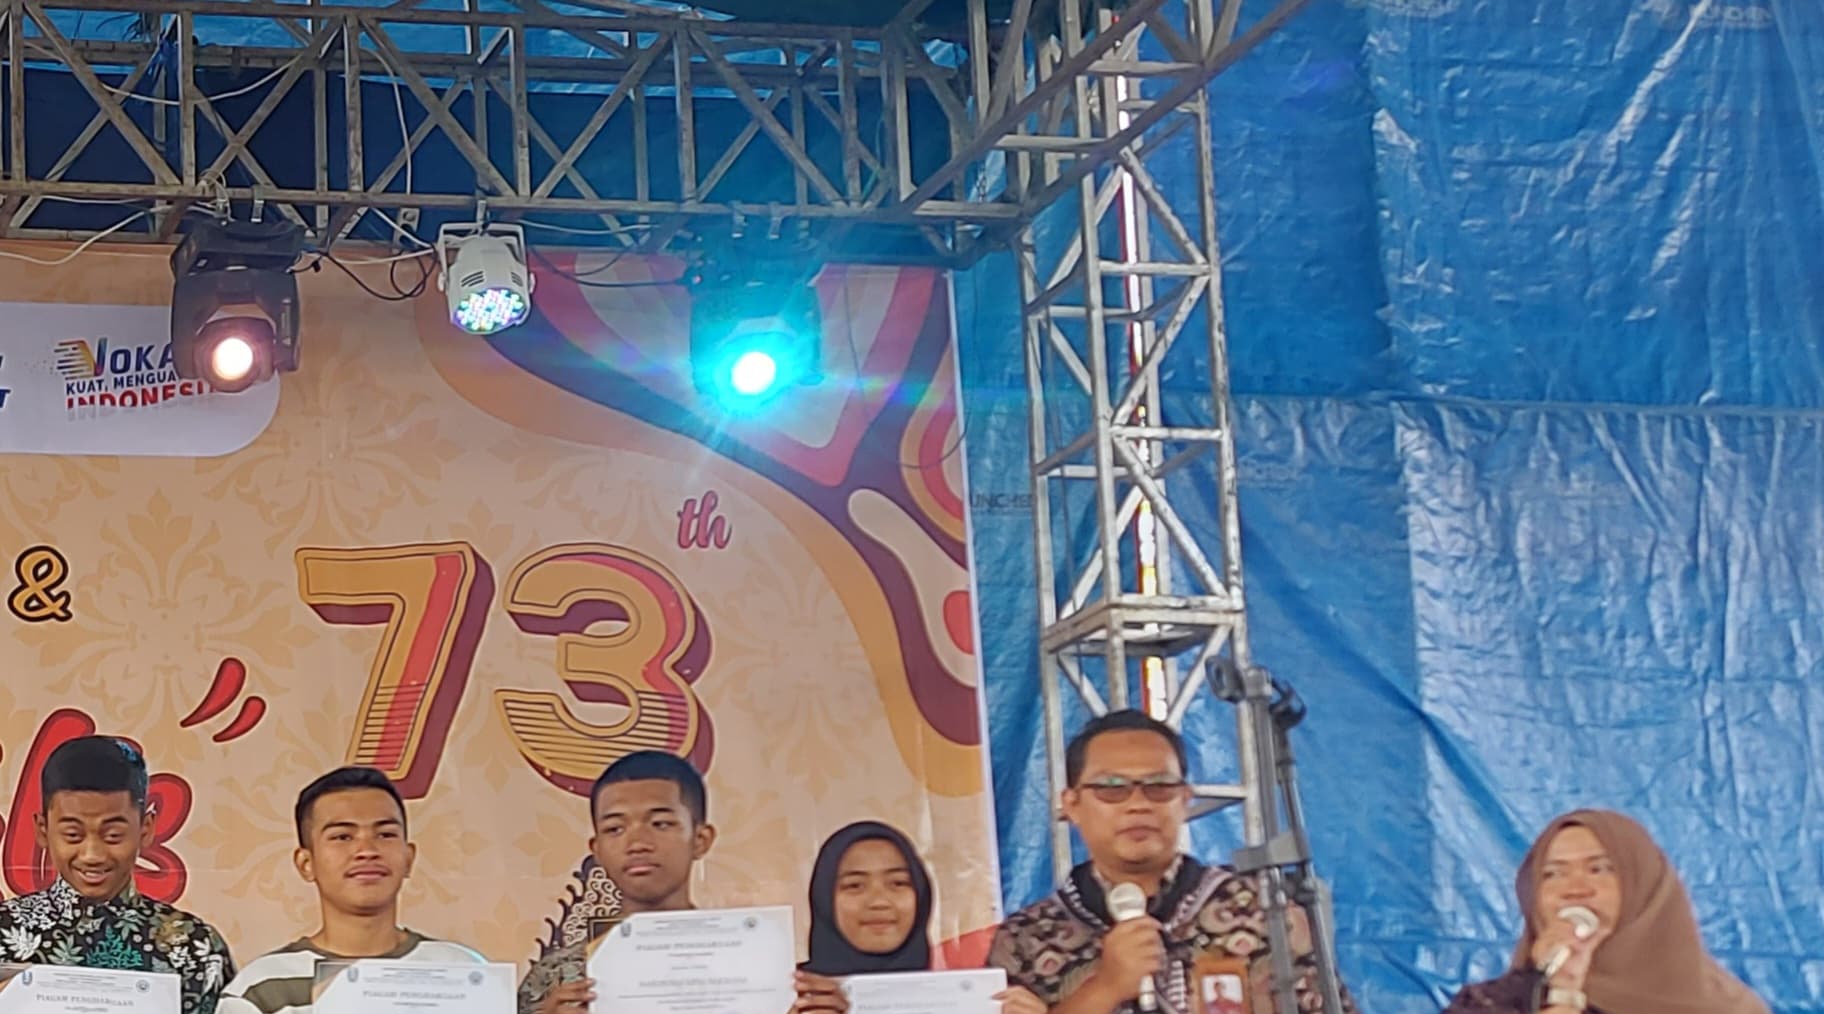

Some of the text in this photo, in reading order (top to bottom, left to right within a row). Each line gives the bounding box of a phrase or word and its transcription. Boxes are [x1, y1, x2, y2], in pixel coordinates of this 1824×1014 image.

[67, 380, 213, 410] INDONESI
[113, 370, 177, 390] MENGUA
[7, 544, 72, 624] &
[294, 490, 733, 800] 73 th
